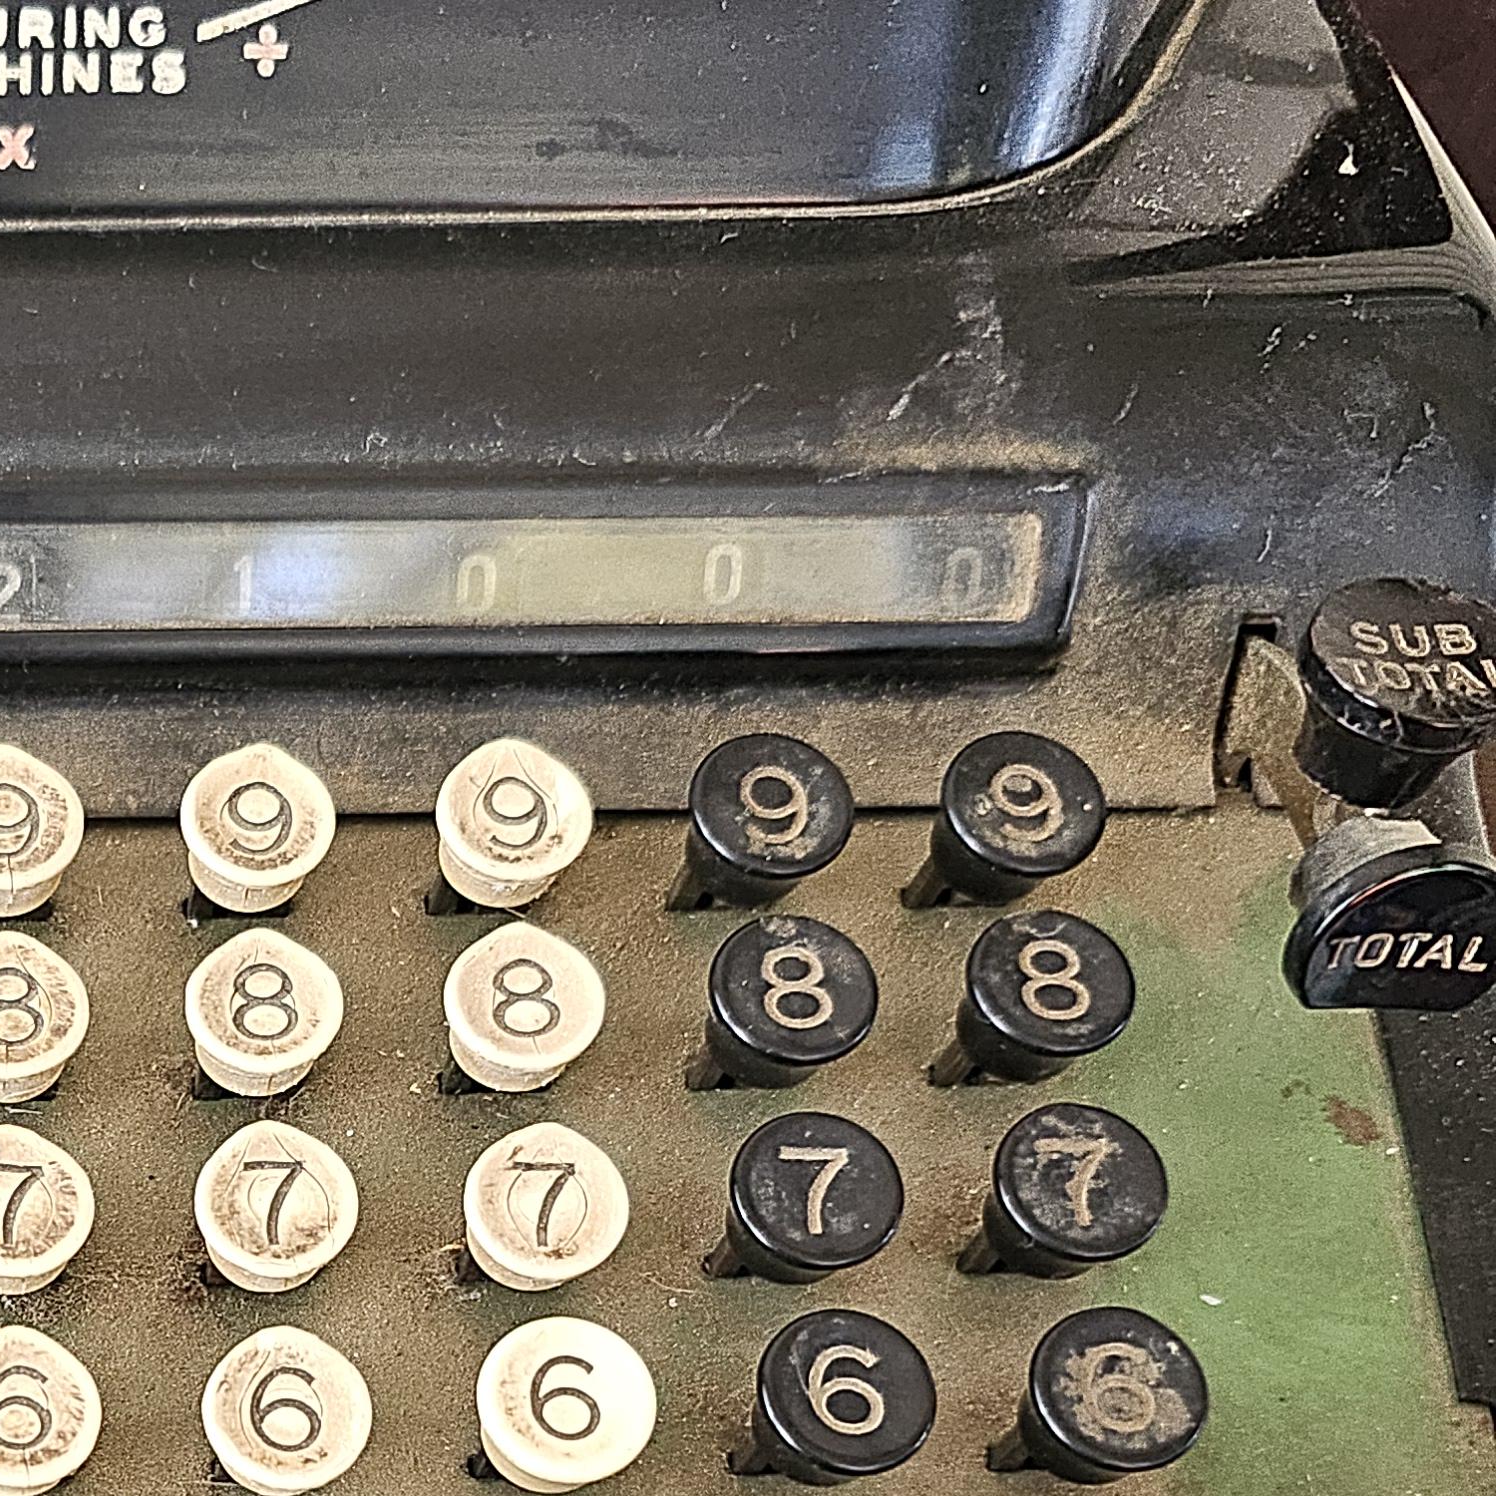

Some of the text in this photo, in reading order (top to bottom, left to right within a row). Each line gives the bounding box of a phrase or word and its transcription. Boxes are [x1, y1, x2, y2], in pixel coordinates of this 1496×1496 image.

[234, 555, 252, 617] 1
[456, 554, 496, 614] 0
[705, 545, 743, 604] 0
[1350, 621, 1477, 657] SUB
[228, 781, 293, 852] 9
[484, 777, 547, 848] 9
[740, 765, 809, 844] 9
[988, 763, 1065, 842] 9
[762, 946, 833, 1029] 8
[1018, 939, 1091, 1020] 8
[1326, 931, 1488, 973] TOTAL
[232, 963, 298, 1040] 8
[493, 958, 561, 1036] 8
[244, 1161, 304, 1245] 7
[509, 1162, 575, 1246] 7
[778, 1145, 849, 1235] 7
[1033, 1138, 1122, 1226] 7
[251, 1366, 321, 1452] 6
[531, 1355, 600, 1440] 6
[809, 1345, 884, 1435] 6
